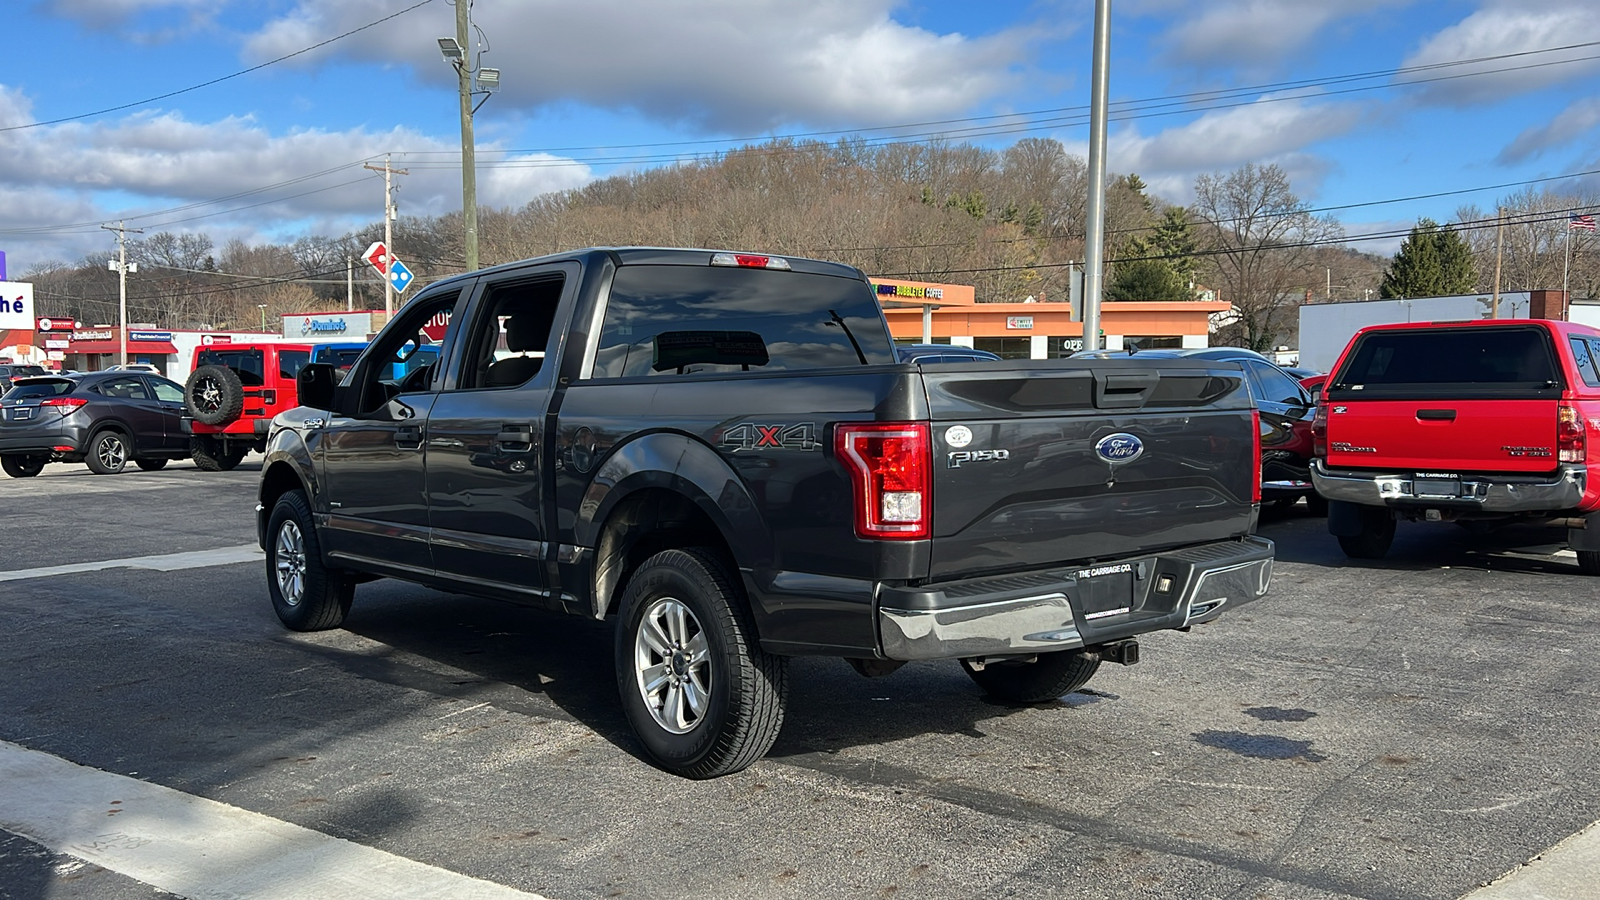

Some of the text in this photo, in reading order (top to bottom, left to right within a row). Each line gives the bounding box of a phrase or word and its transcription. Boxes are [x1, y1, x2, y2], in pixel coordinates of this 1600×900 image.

[926, 287, 944, 299] COFFEE
[310, 317, 346, 331] Domino's
[1064, 339, 1083, 350] OPE
[1107, 438, 1135, 457] Ford
[1078, 563, 1132, 578] THE CARRIAGE CO.
